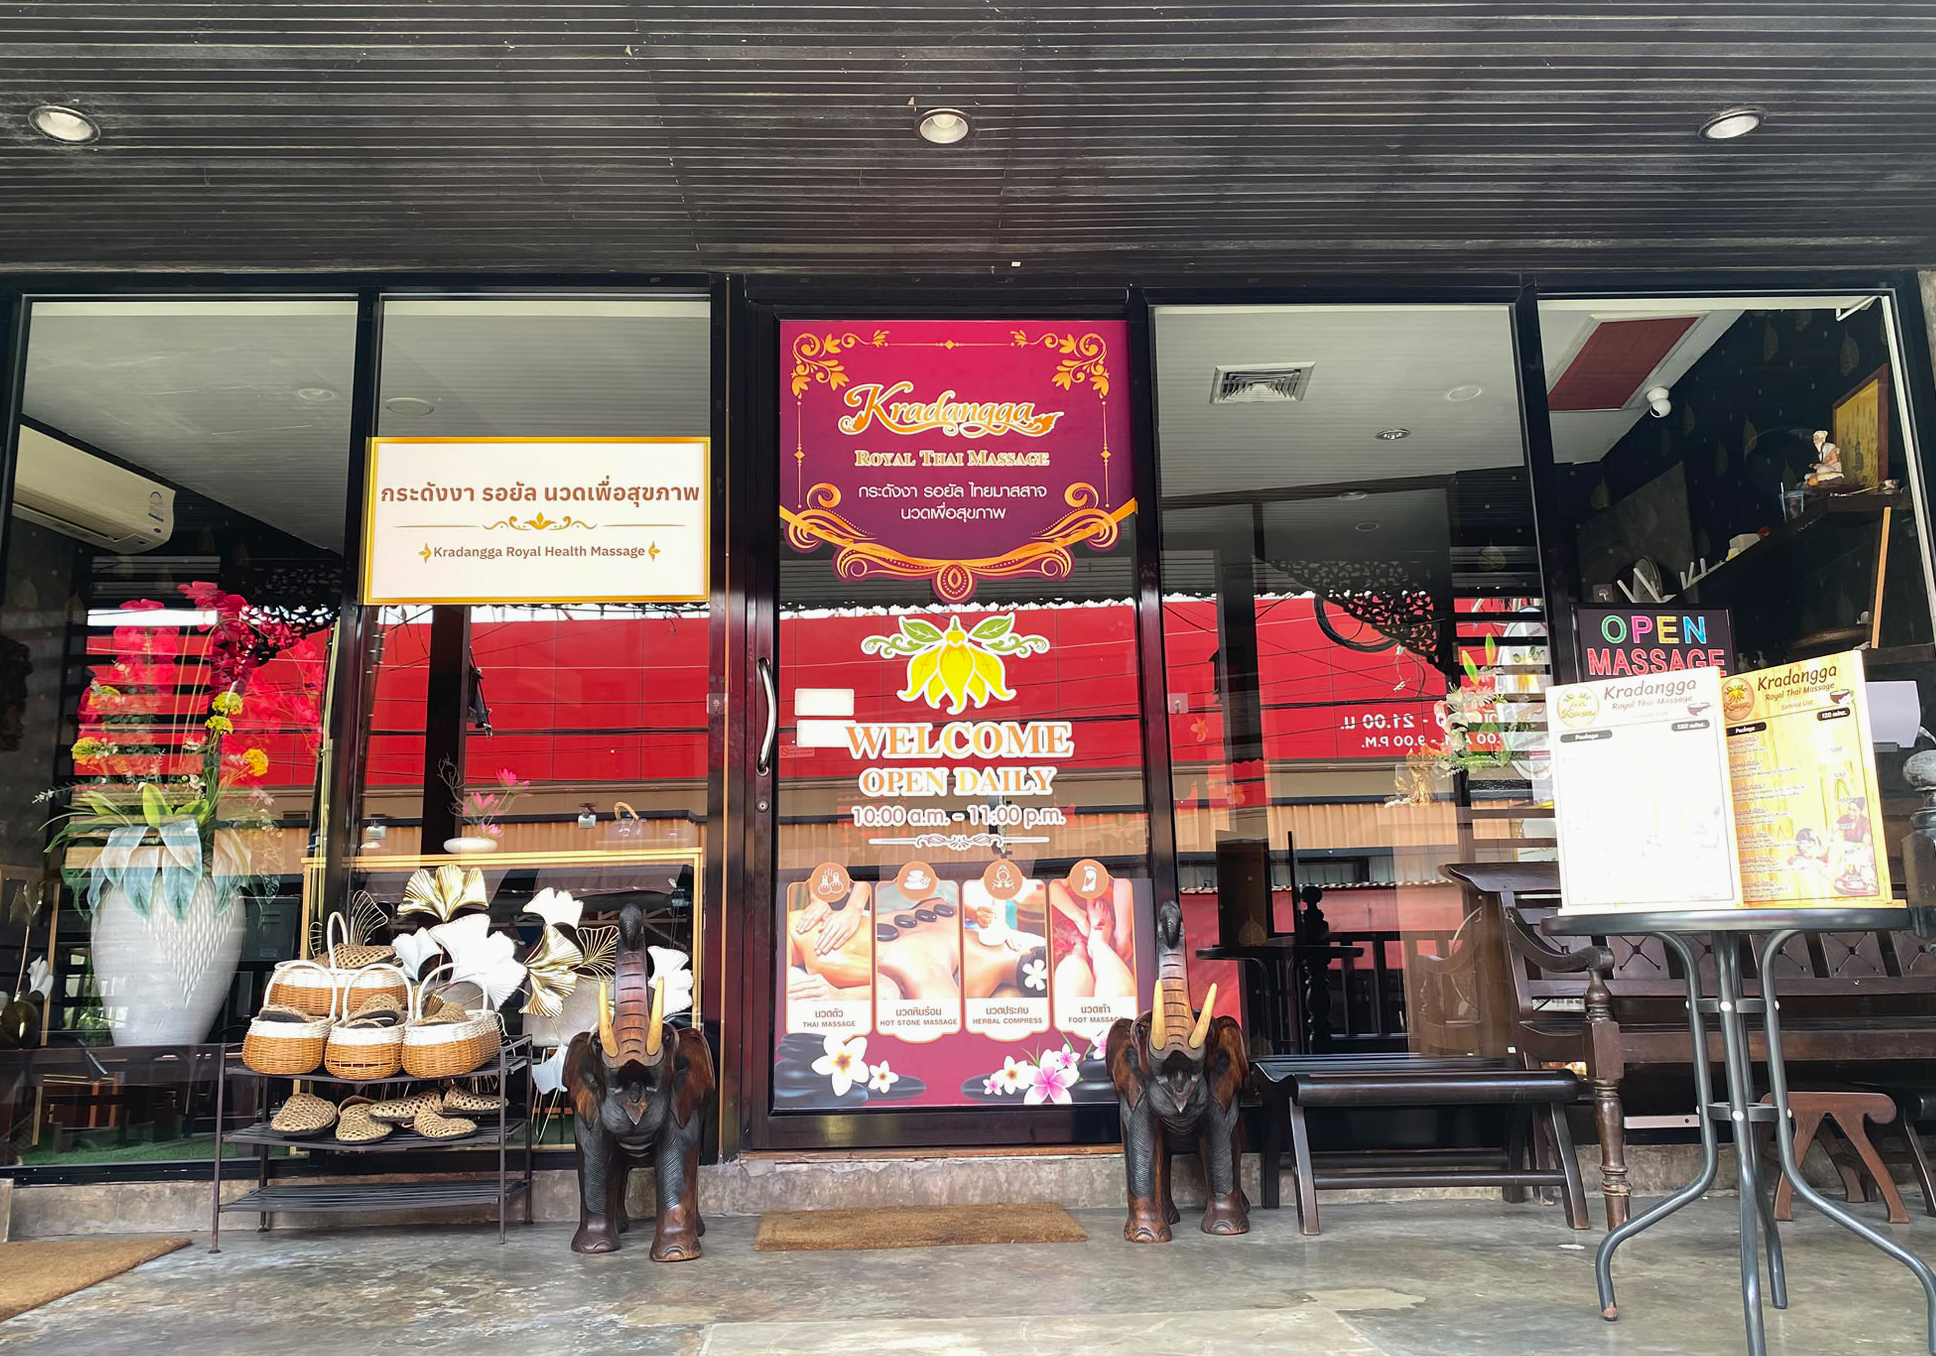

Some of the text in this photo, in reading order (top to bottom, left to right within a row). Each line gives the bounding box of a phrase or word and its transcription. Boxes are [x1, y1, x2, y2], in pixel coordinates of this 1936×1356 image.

[838, 381, 1063, 438] Kradangga
[381, 475, 700, 508] กระดังงา รอยัล นวดเพื่อสุขภาพ
[858, 481, 1048, 498] กระดังงา รอยัล ไทยมาสสาจ
[900, 502, 1007, 523] นวดเพื่อสุขภาพ
[433, 546, 646, 560] Kradangga Royal Health Massage
[1601, 615, 1707, 644] OPEN
[1587, 647, 1728, 677] MASSAGE
[1757, 665, 1837, 692] Kradangga
[1604, 679, 1697, 701] Kradangga
[1764, 682, 1835, 702] Royal Thai Massage
[1612, 700, 1635, 711] Royal
[1657, 695, 1693, 705] Massage
[844, 723, 1072, 757] WELCOME
[860, 768, 1055, 794] OPEN DAILY
[852, 807, 906, 825] 10:00
[908, 808, 950, 825] a.m.
[967, 806, 1022, 825] 11:00
[1024, 807, 1066, 829] p.m.
[815, 1007, 844, 1018] นวดตัว
[895, 1006, 942, 1017] นวดหินร้อน
[986, 1006, 1029, 1015] นวดประคบ
[1081, 1003, 1111, 1014] นวดเท้า
[821, 1020, 856, 1028] MASSAGE
[923, 1018, 958, 1026] MASSAGE
[973, 1016, 1043, 1025] HERBAL COMPRESS
